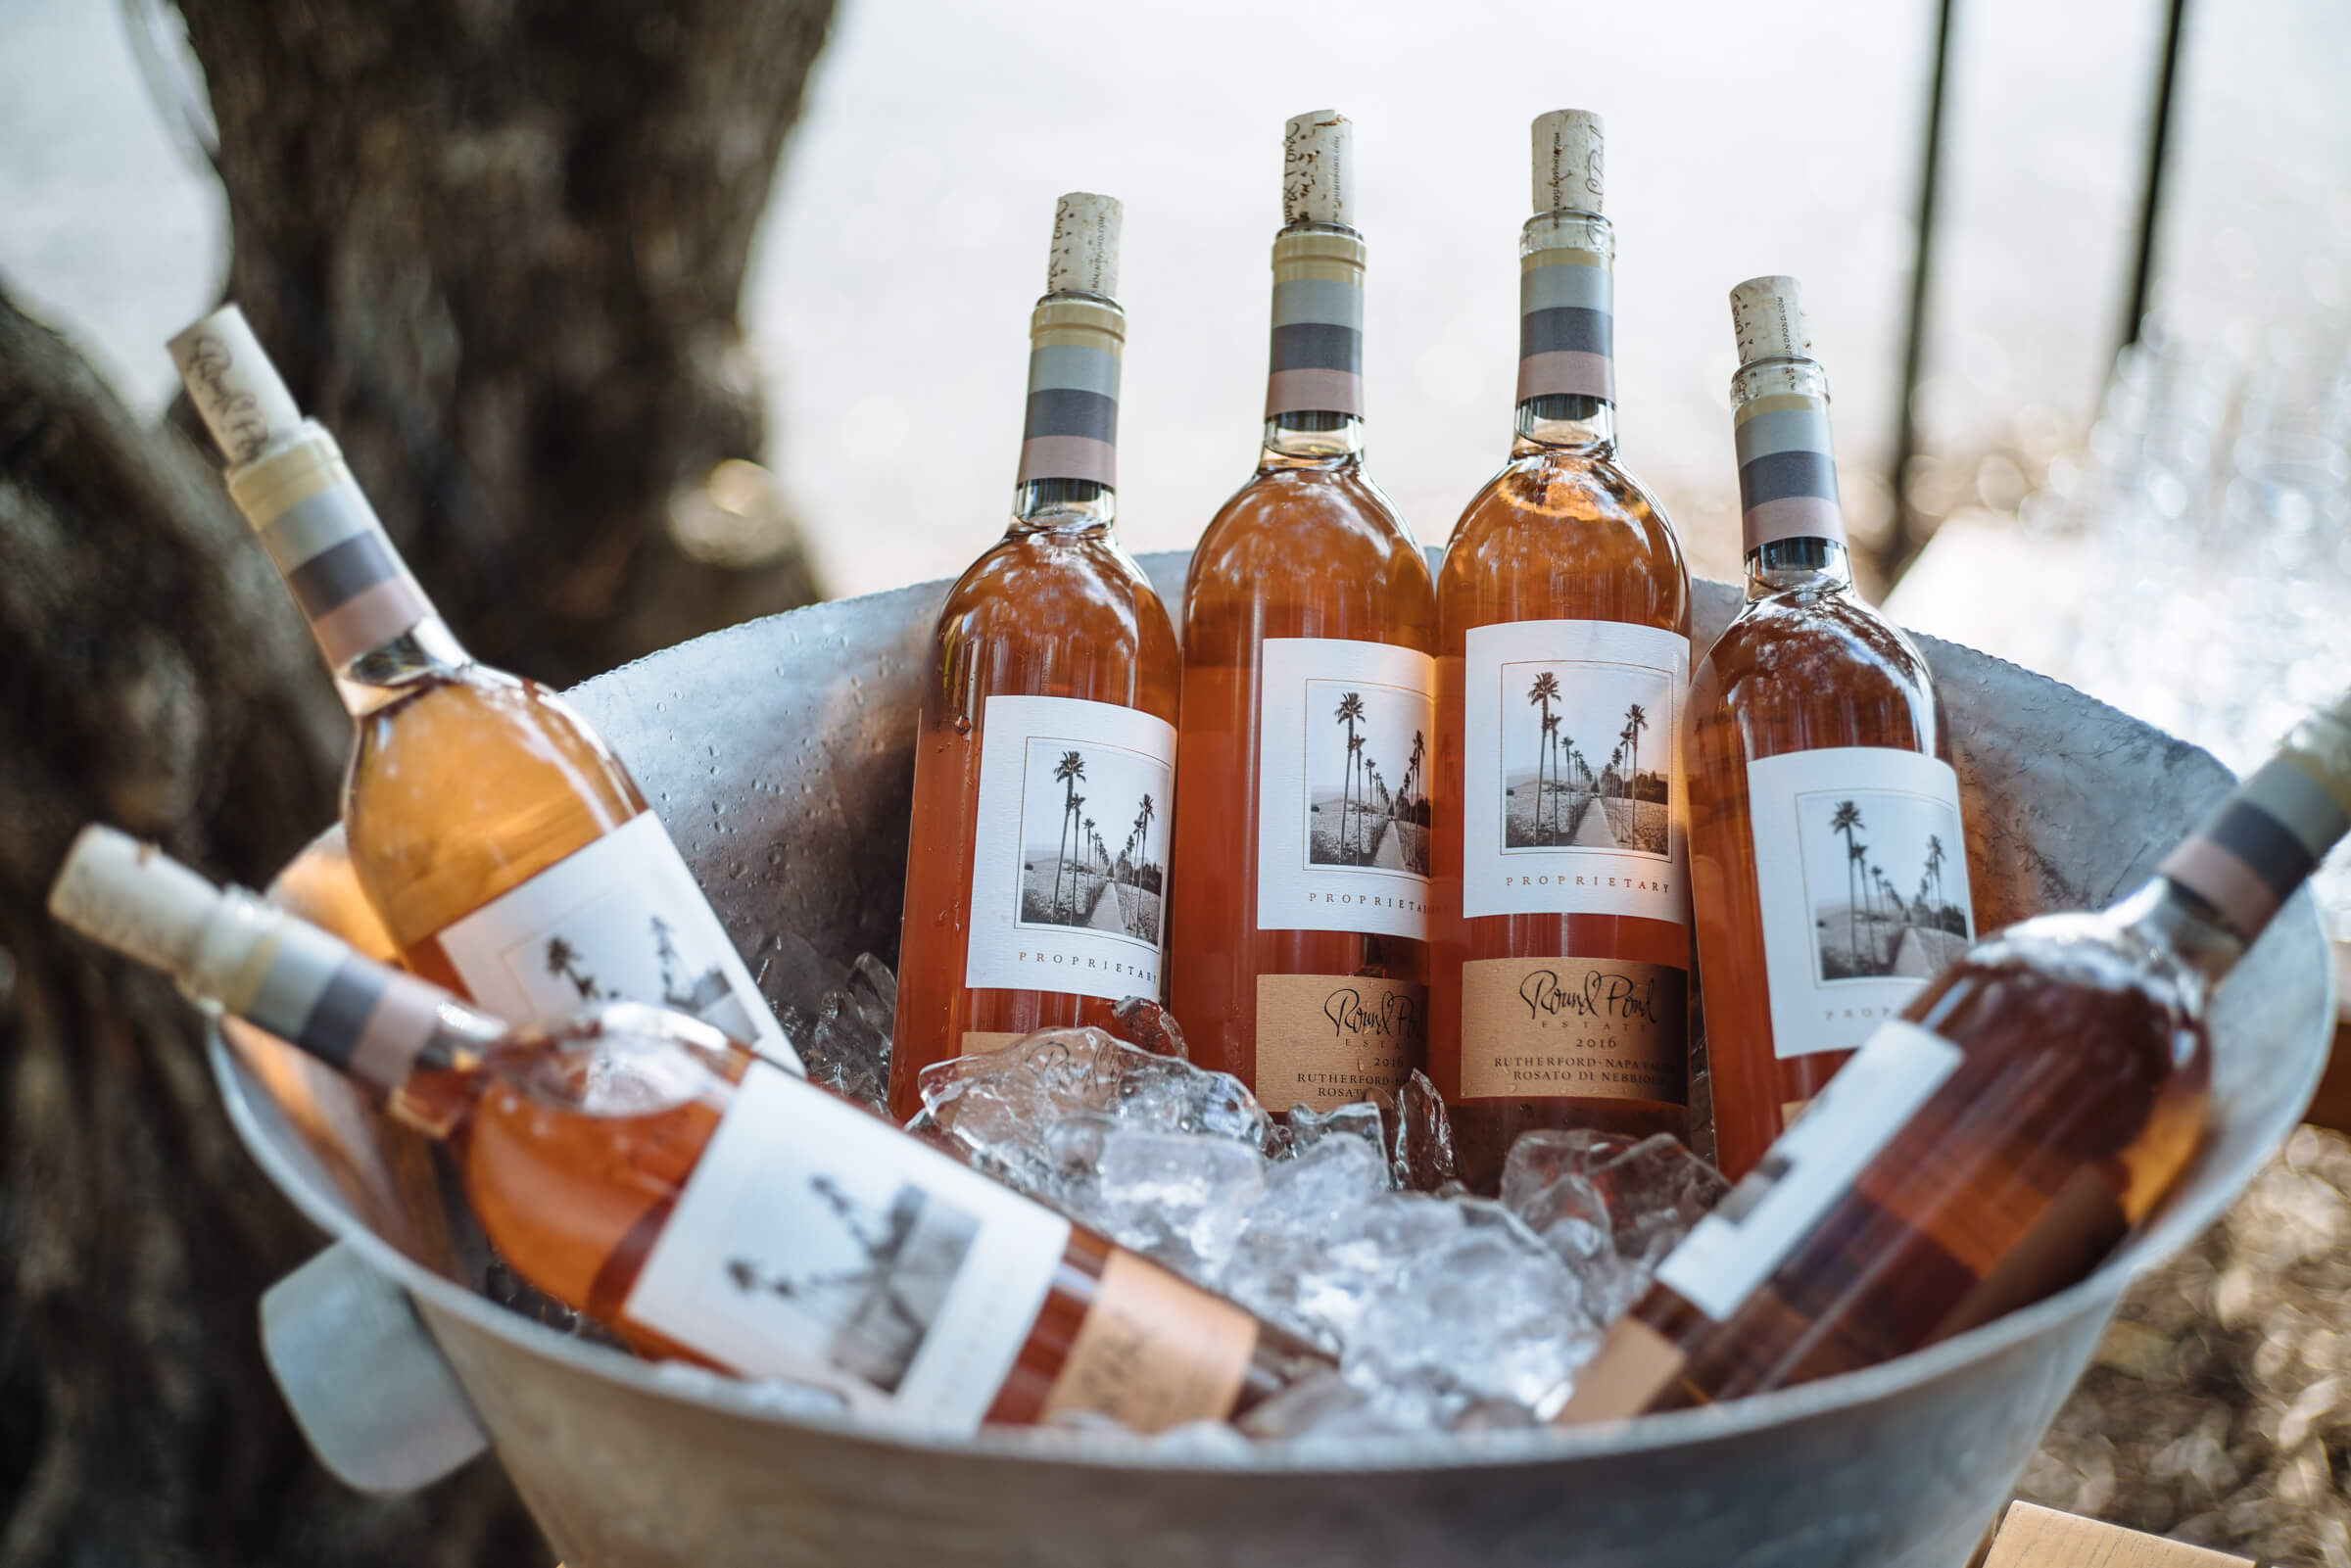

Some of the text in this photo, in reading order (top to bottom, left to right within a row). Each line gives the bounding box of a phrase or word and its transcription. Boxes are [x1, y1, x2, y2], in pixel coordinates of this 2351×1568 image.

[1507, 876, 1669, 894] PROPRIETARY
[1519, 970, 1657, 1023] Round Pond
[1575, 1037, 1617, 1049] 2016
[1513, 1070, 1571, 1081] ROSATO
[1579, 1071, 1595, 1082] DI
